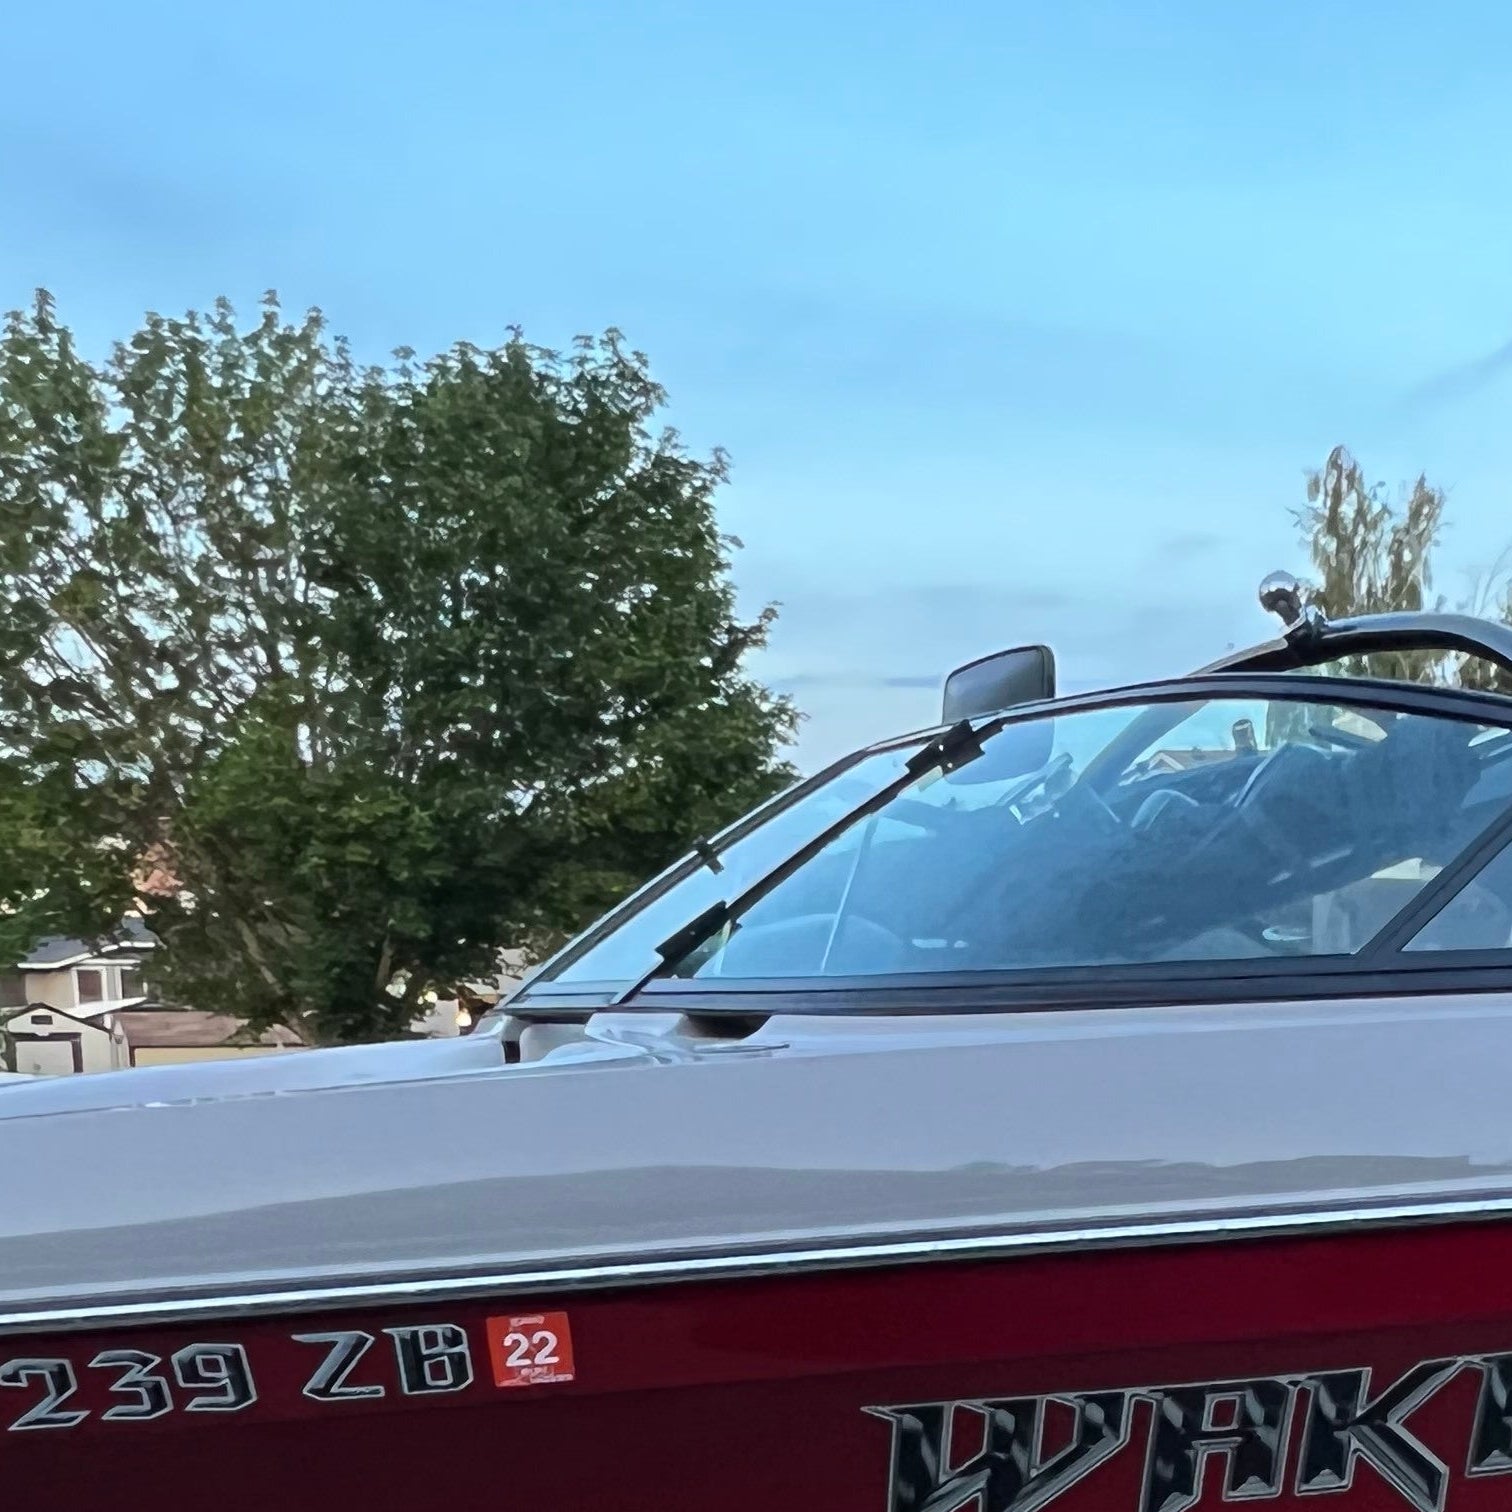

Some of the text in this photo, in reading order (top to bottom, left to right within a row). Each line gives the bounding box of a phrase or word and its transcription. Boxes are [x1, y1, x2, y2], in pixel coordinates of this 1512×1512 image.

[0, 1323, 474, 1431] 239 ZB
[503, 1331, 560, 1367] 22
